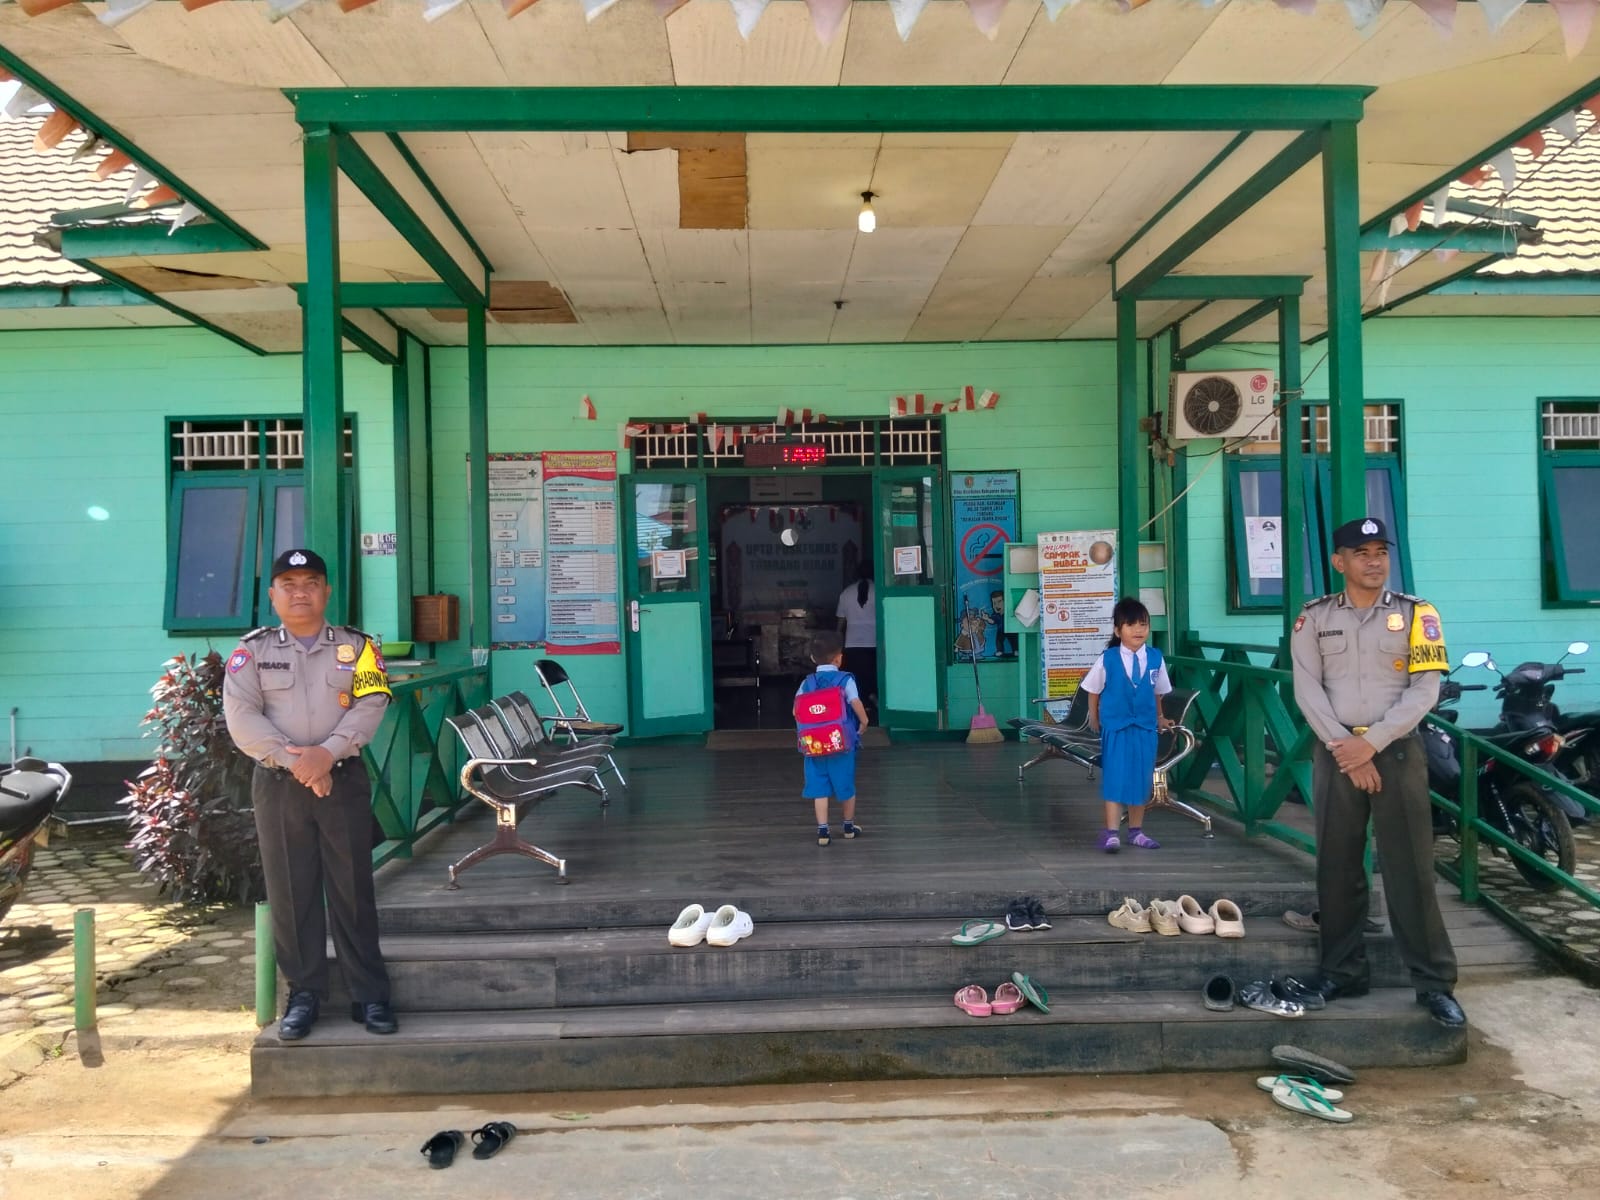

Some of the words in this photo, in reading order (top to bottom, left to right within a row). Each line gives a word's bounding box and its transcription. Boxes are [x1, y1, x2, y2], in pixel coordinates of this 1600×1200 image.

[1251, 395, 1265, 405] LG
[1044, 551, 1080, 559] CAMPAK
[1053, 559, 1088, 568] RUBELA
